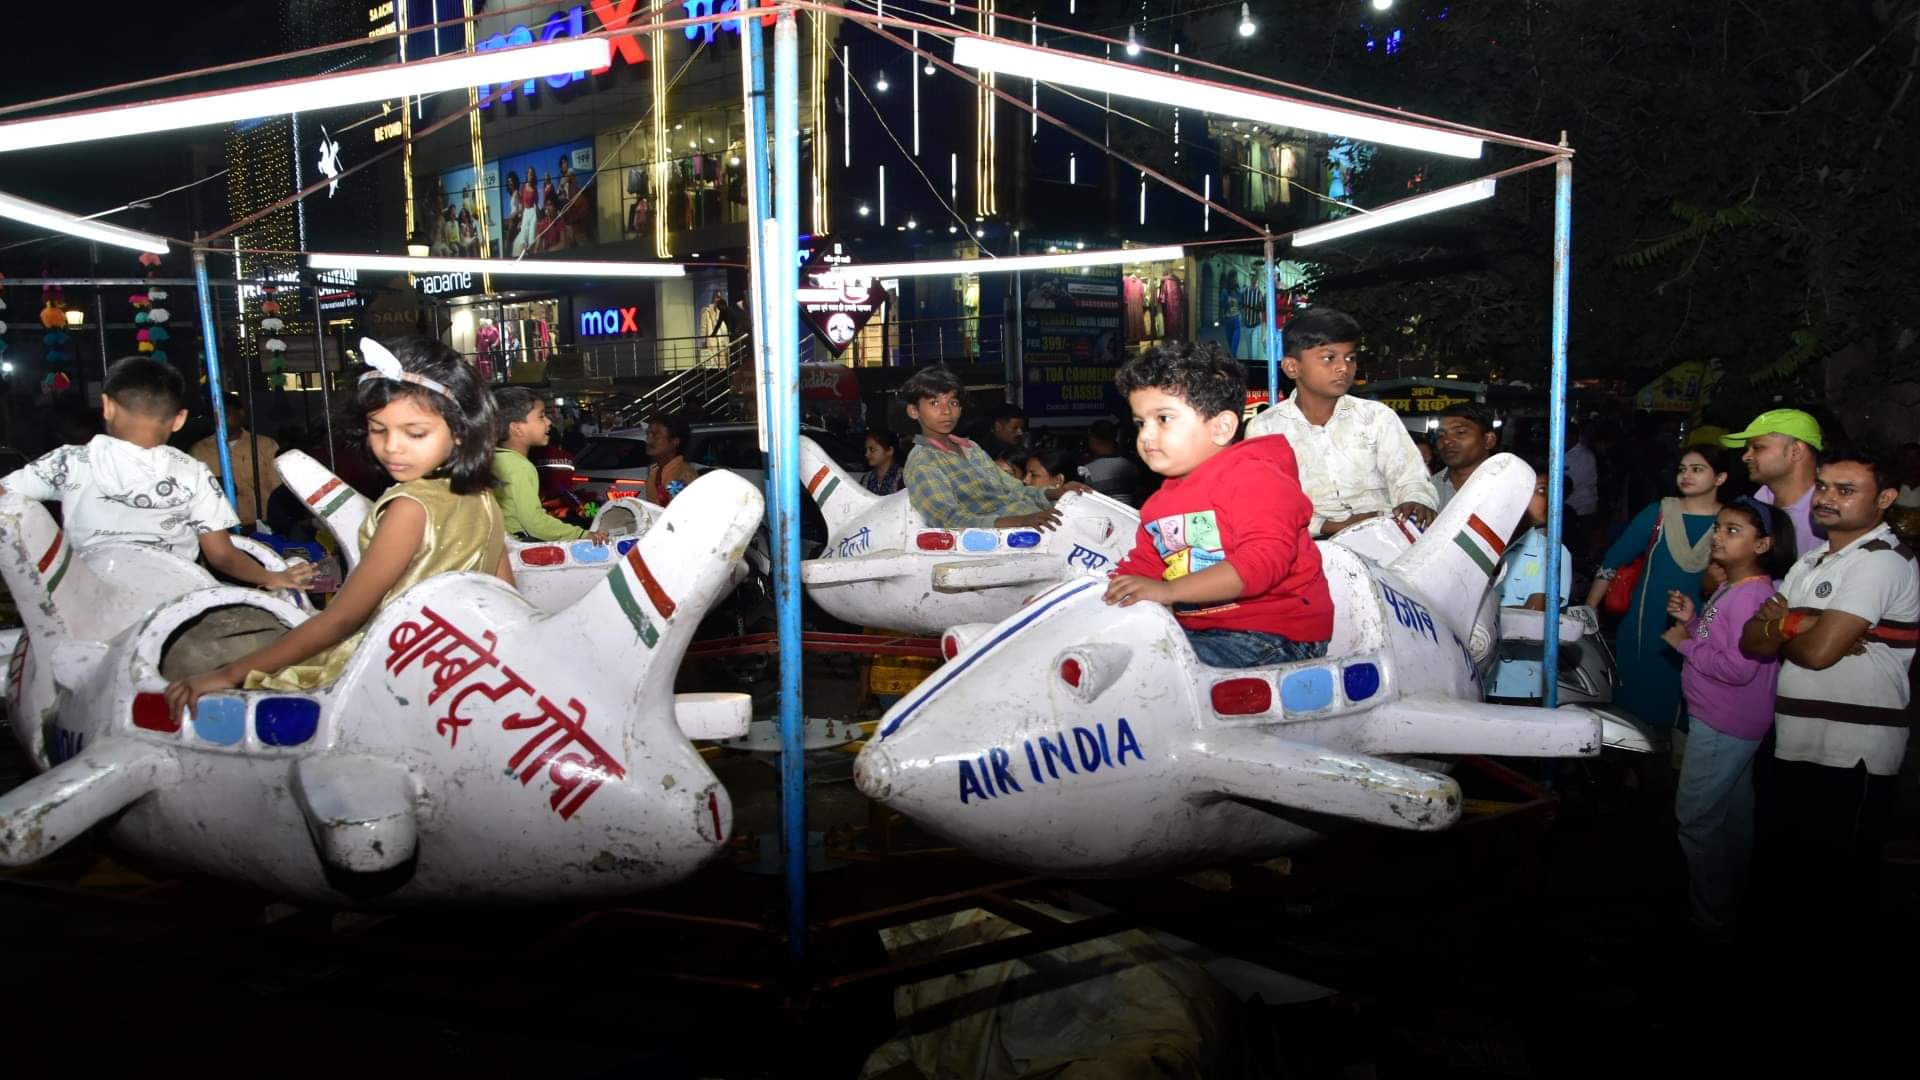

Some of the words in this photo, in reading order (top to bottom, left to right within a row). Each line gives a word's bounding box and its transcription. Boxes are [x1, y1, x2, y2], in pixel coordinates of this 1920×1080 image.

[374, 121, 402, 142] BEYOND
[581, 306, 639, 335] max
[502, 695, 626, 822] गोवा
[958, 747, 1024, 804] AIR
[1024, 718, 1146, 784] INDIA
